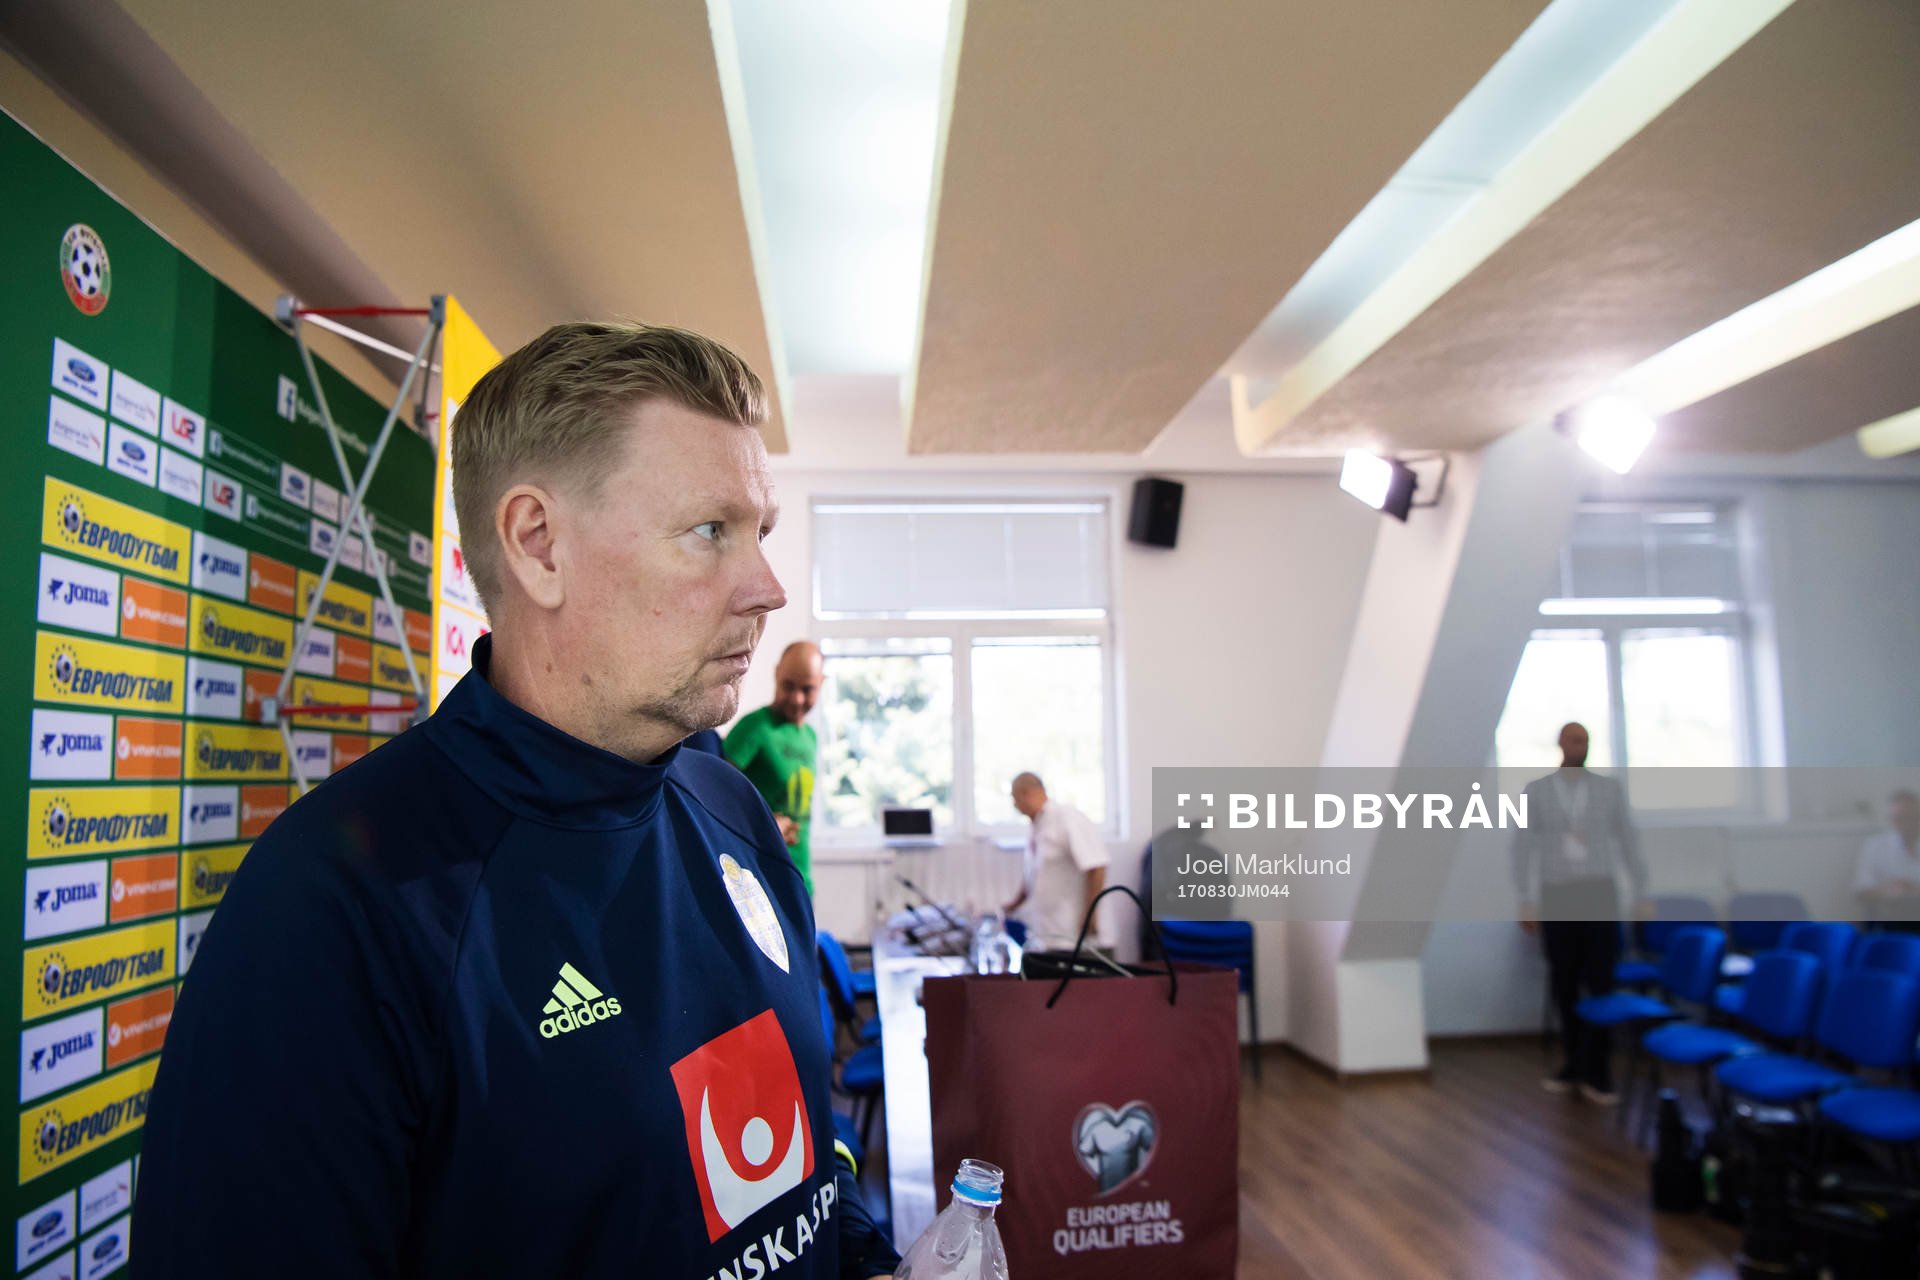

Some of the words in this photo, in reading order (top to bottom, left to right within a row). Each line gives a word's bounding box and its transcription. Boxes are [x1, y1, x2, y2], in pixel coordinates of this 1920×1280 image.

[78, 519, 179, 571] ЕВРОФУТБОЛ
[71, 668, 173, 703] ЕВРОФУТБОЛ
[65, 812, 168, 845] ЕВРОФУТБОЛ
[60, 947, 164, 999] ЕВРОФУТБОЛ
[539, 995, 622, 1039] adidas
[706, 1213, 814, 1280] NSKA
[812, 1174, 839, 1233] SP
[1066, 1200, 1170, 1227] EUROPEAN
[1053, 1219, 1185, 1256] QUALIFIERS
